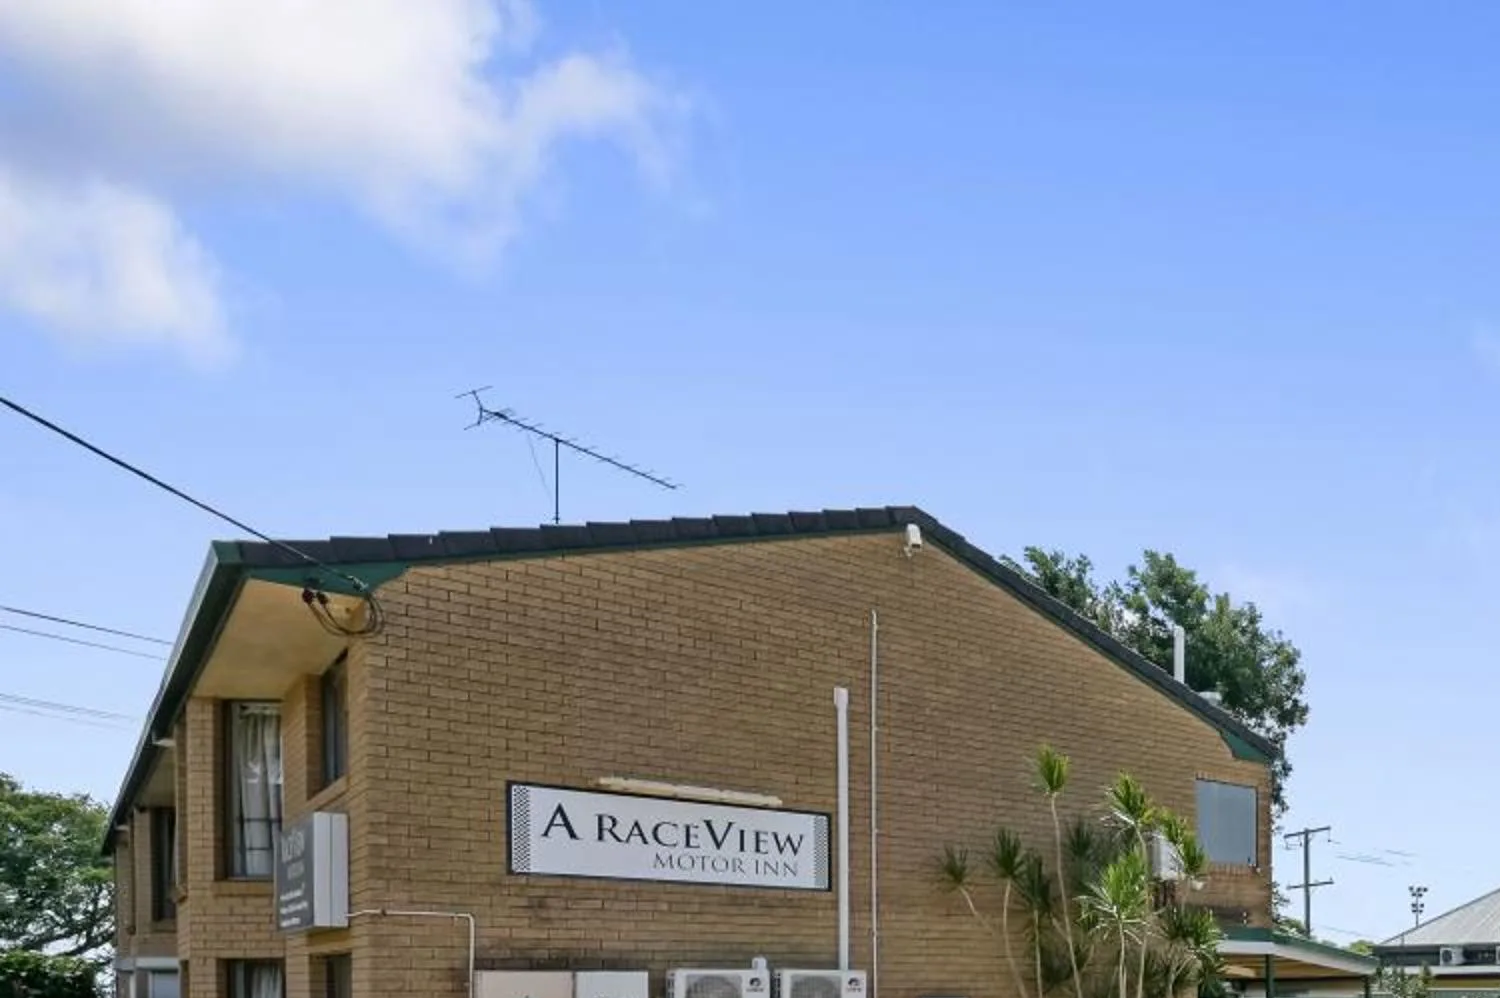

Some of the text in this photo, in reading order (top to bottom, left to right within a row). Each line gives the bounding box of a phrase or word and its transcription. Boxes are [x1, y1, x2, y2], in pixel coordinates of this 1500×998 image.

[541, 802, 581, 841] A
[652, 853, 799, 878] MOTOR INN
